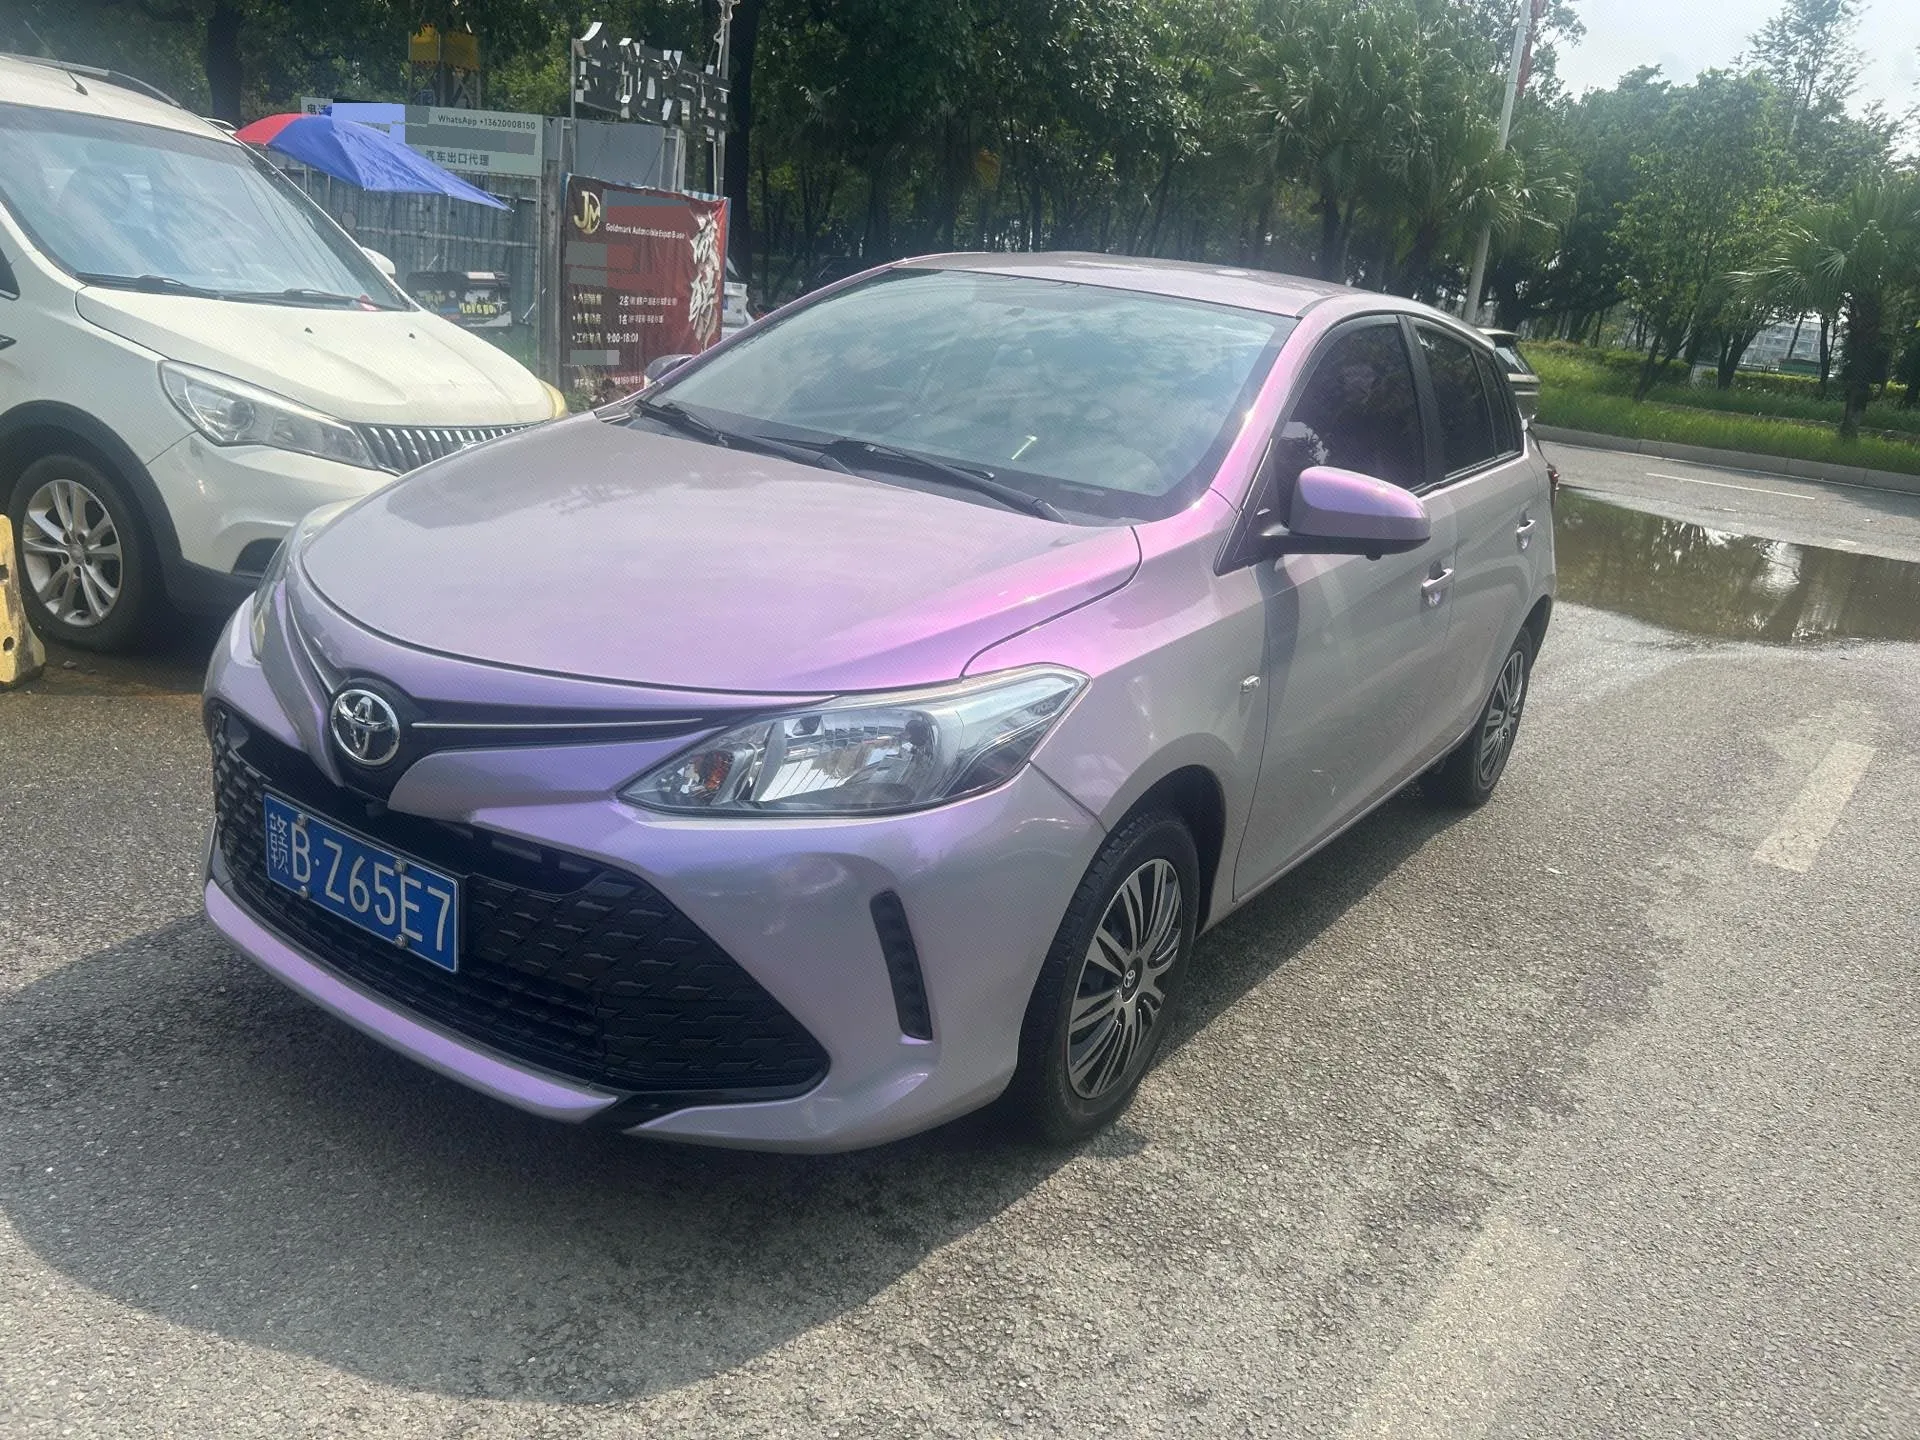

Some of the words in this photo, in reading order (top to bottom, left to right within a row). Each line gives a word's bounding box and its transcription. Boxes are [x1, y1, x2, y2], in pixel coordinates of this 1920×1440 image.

[438, 114, 477, 126] WhatsApp
[425, 149, 489, 167] 汽车出口代理
[605, 222, 632, 234] Goldmark
